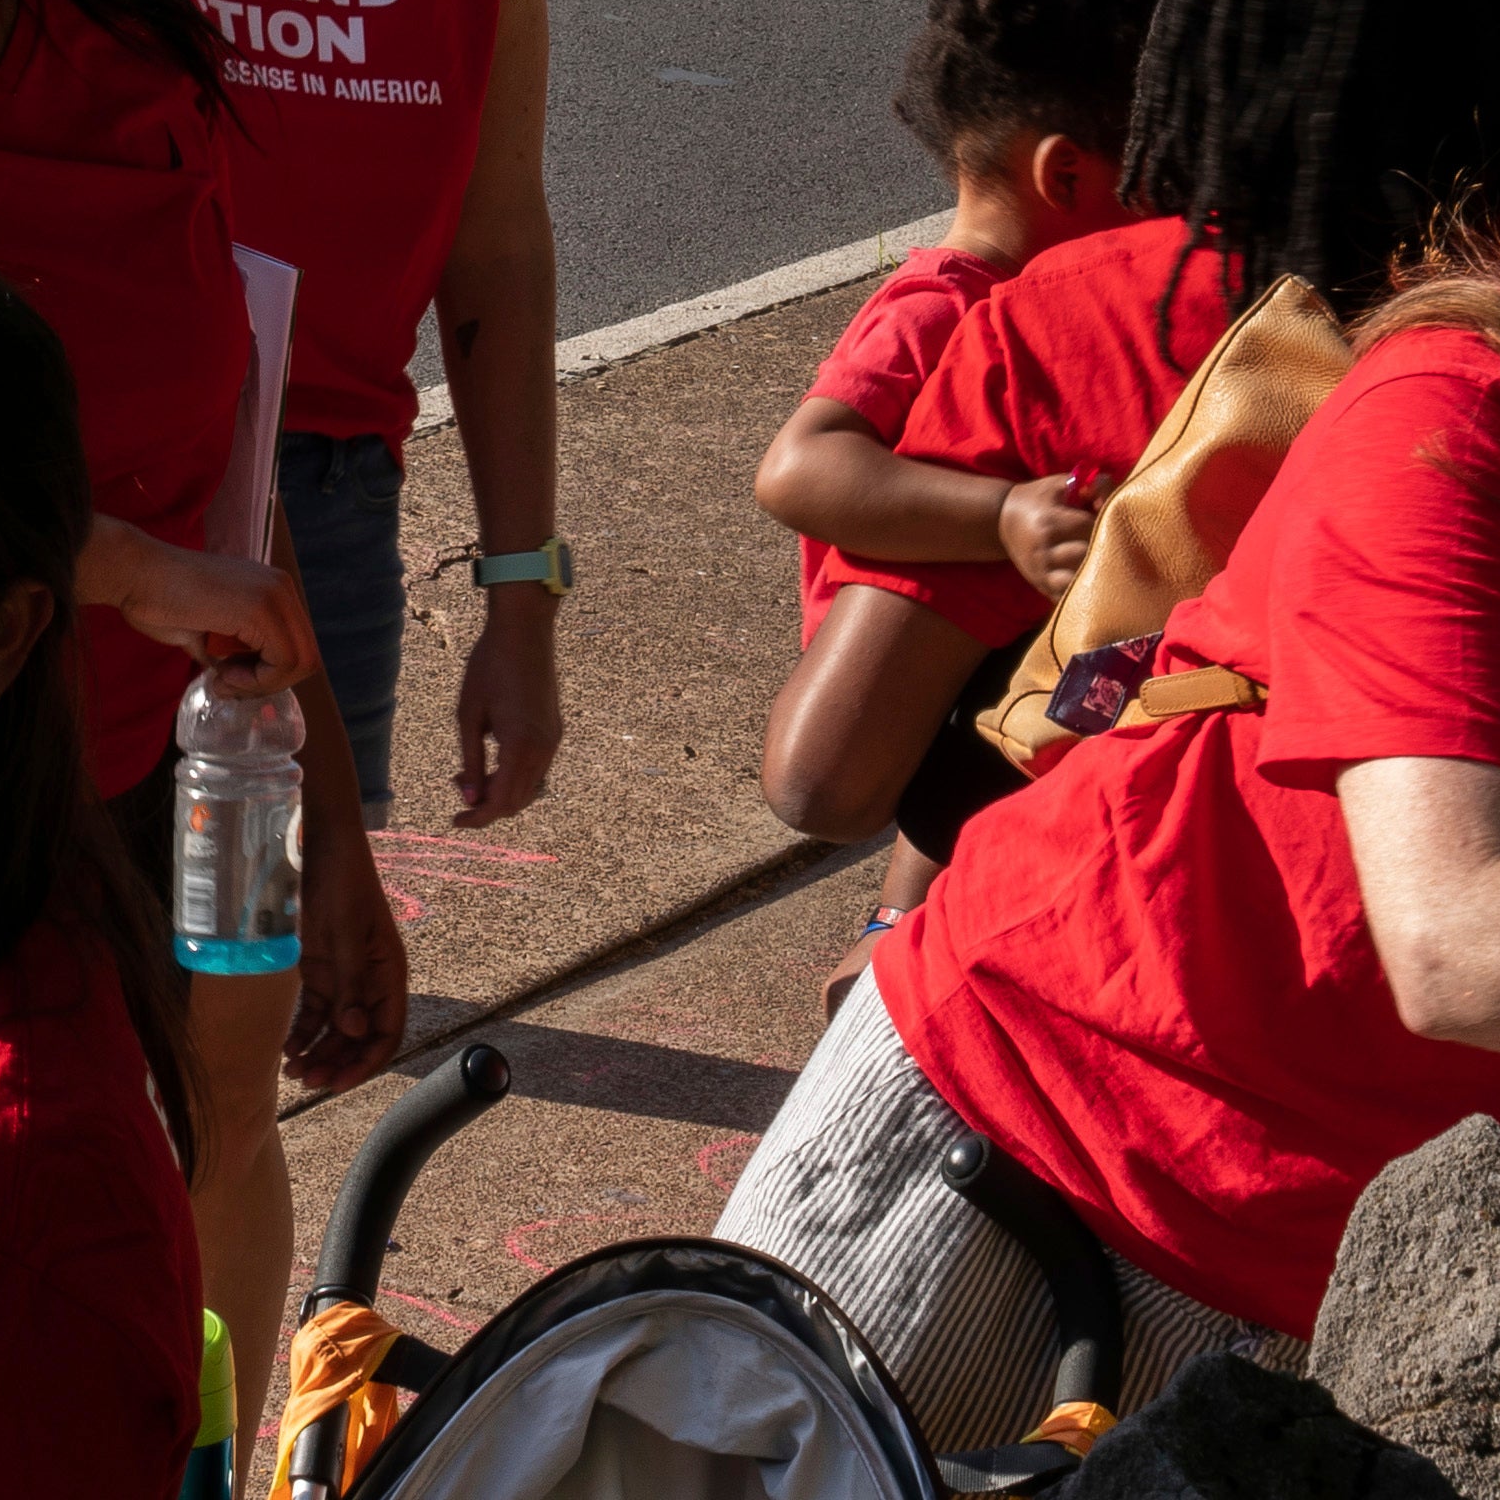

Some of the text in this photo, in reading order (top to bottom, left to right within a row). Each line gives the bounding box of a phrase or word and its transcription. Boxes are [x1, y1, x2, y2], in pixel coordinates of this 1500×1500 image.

[224, 59, 442, 105] SENSE IN AMERICA
